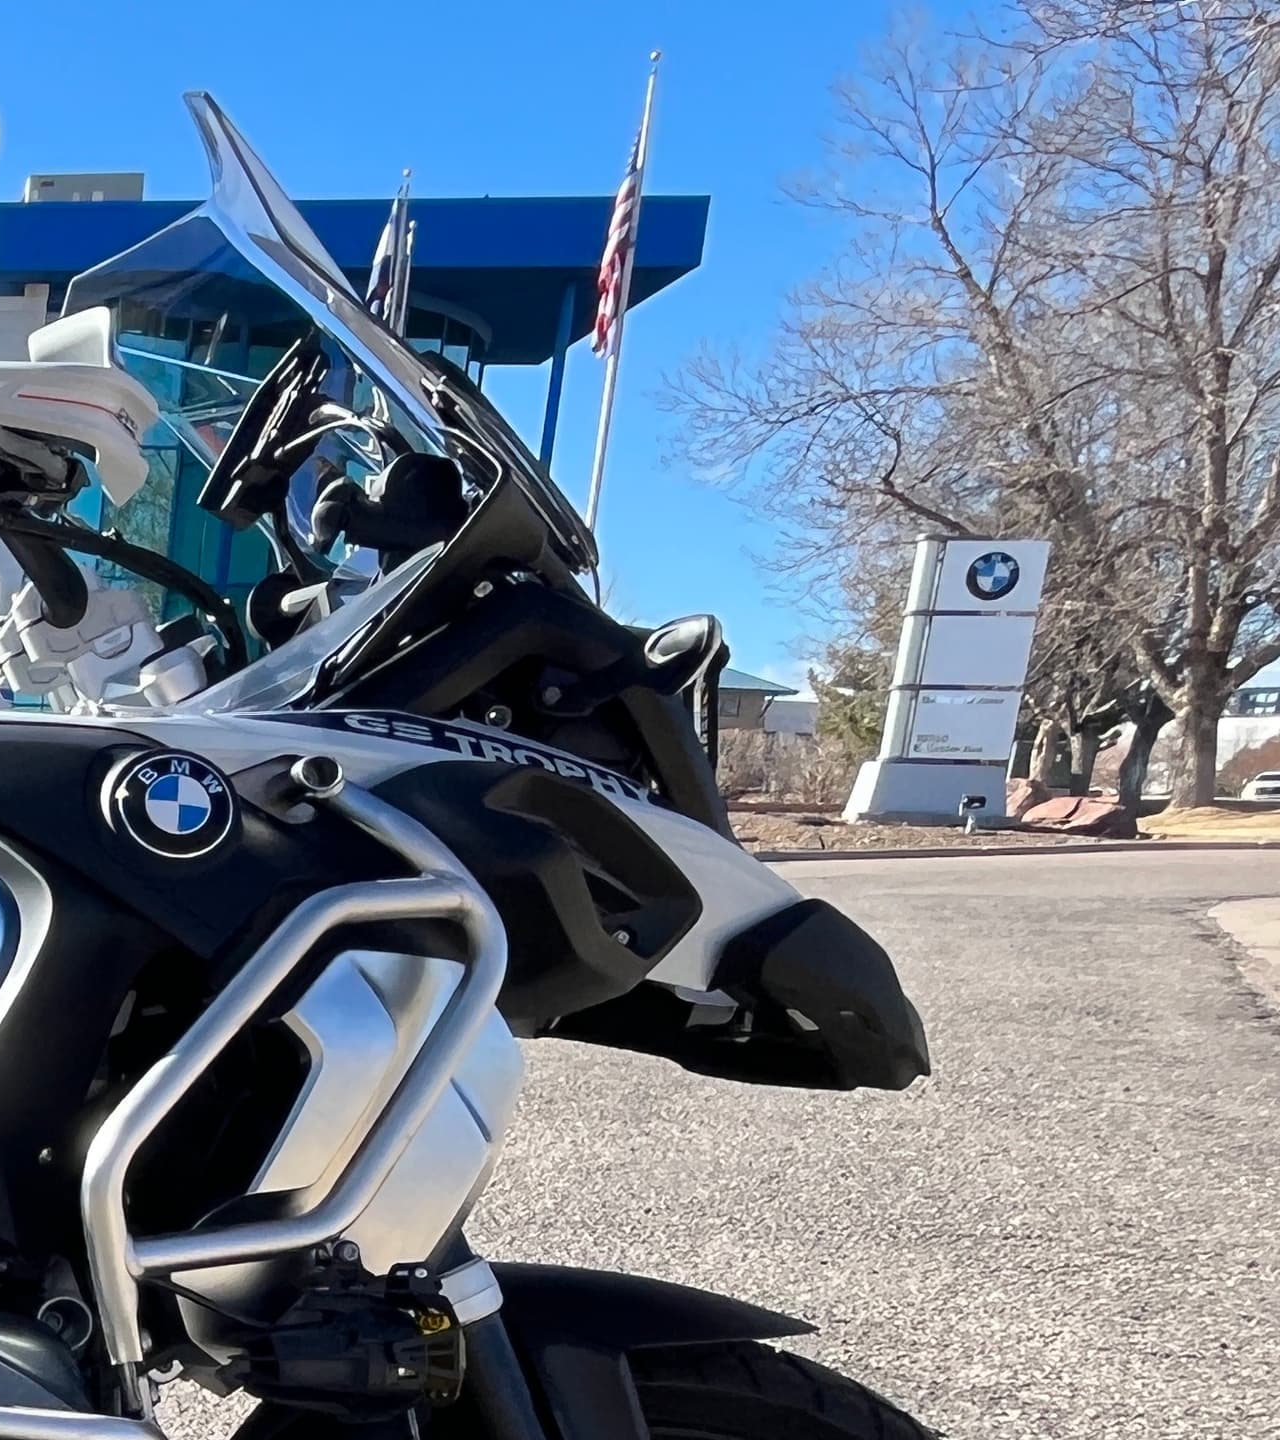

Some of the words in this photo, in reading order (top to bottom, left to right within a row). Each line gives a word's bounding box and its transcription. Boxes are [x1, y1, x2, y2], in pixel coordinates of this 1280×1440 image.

[138, 760, 223, 794] BMW
[343, 714, 433, 741] GS
[444, 731, 651, 802] TROPHY
